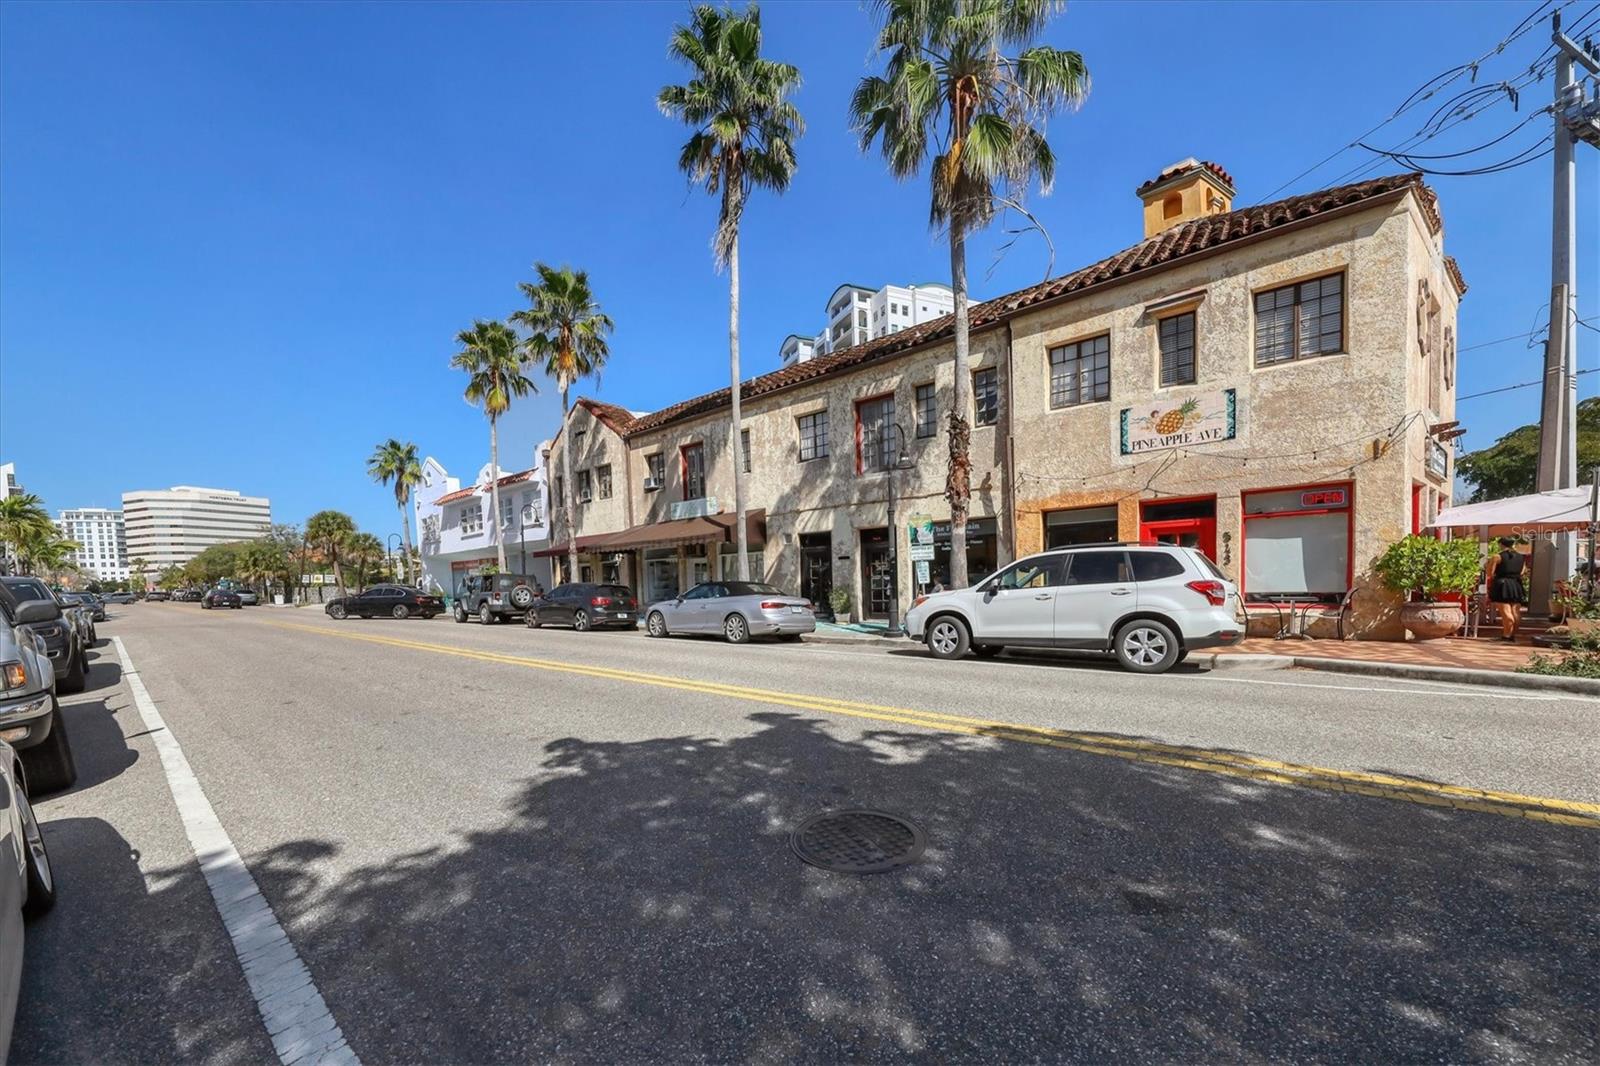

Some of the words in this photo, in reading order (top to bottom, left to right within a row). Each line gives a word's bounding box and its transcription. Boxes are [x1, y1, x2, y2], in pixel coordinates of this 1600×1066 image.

[1132, 433, 1192, 450] PINEAPPLE
[1199, 428, 1222, 440] AVE
[1304, 492, 1342, 505] OPEN
